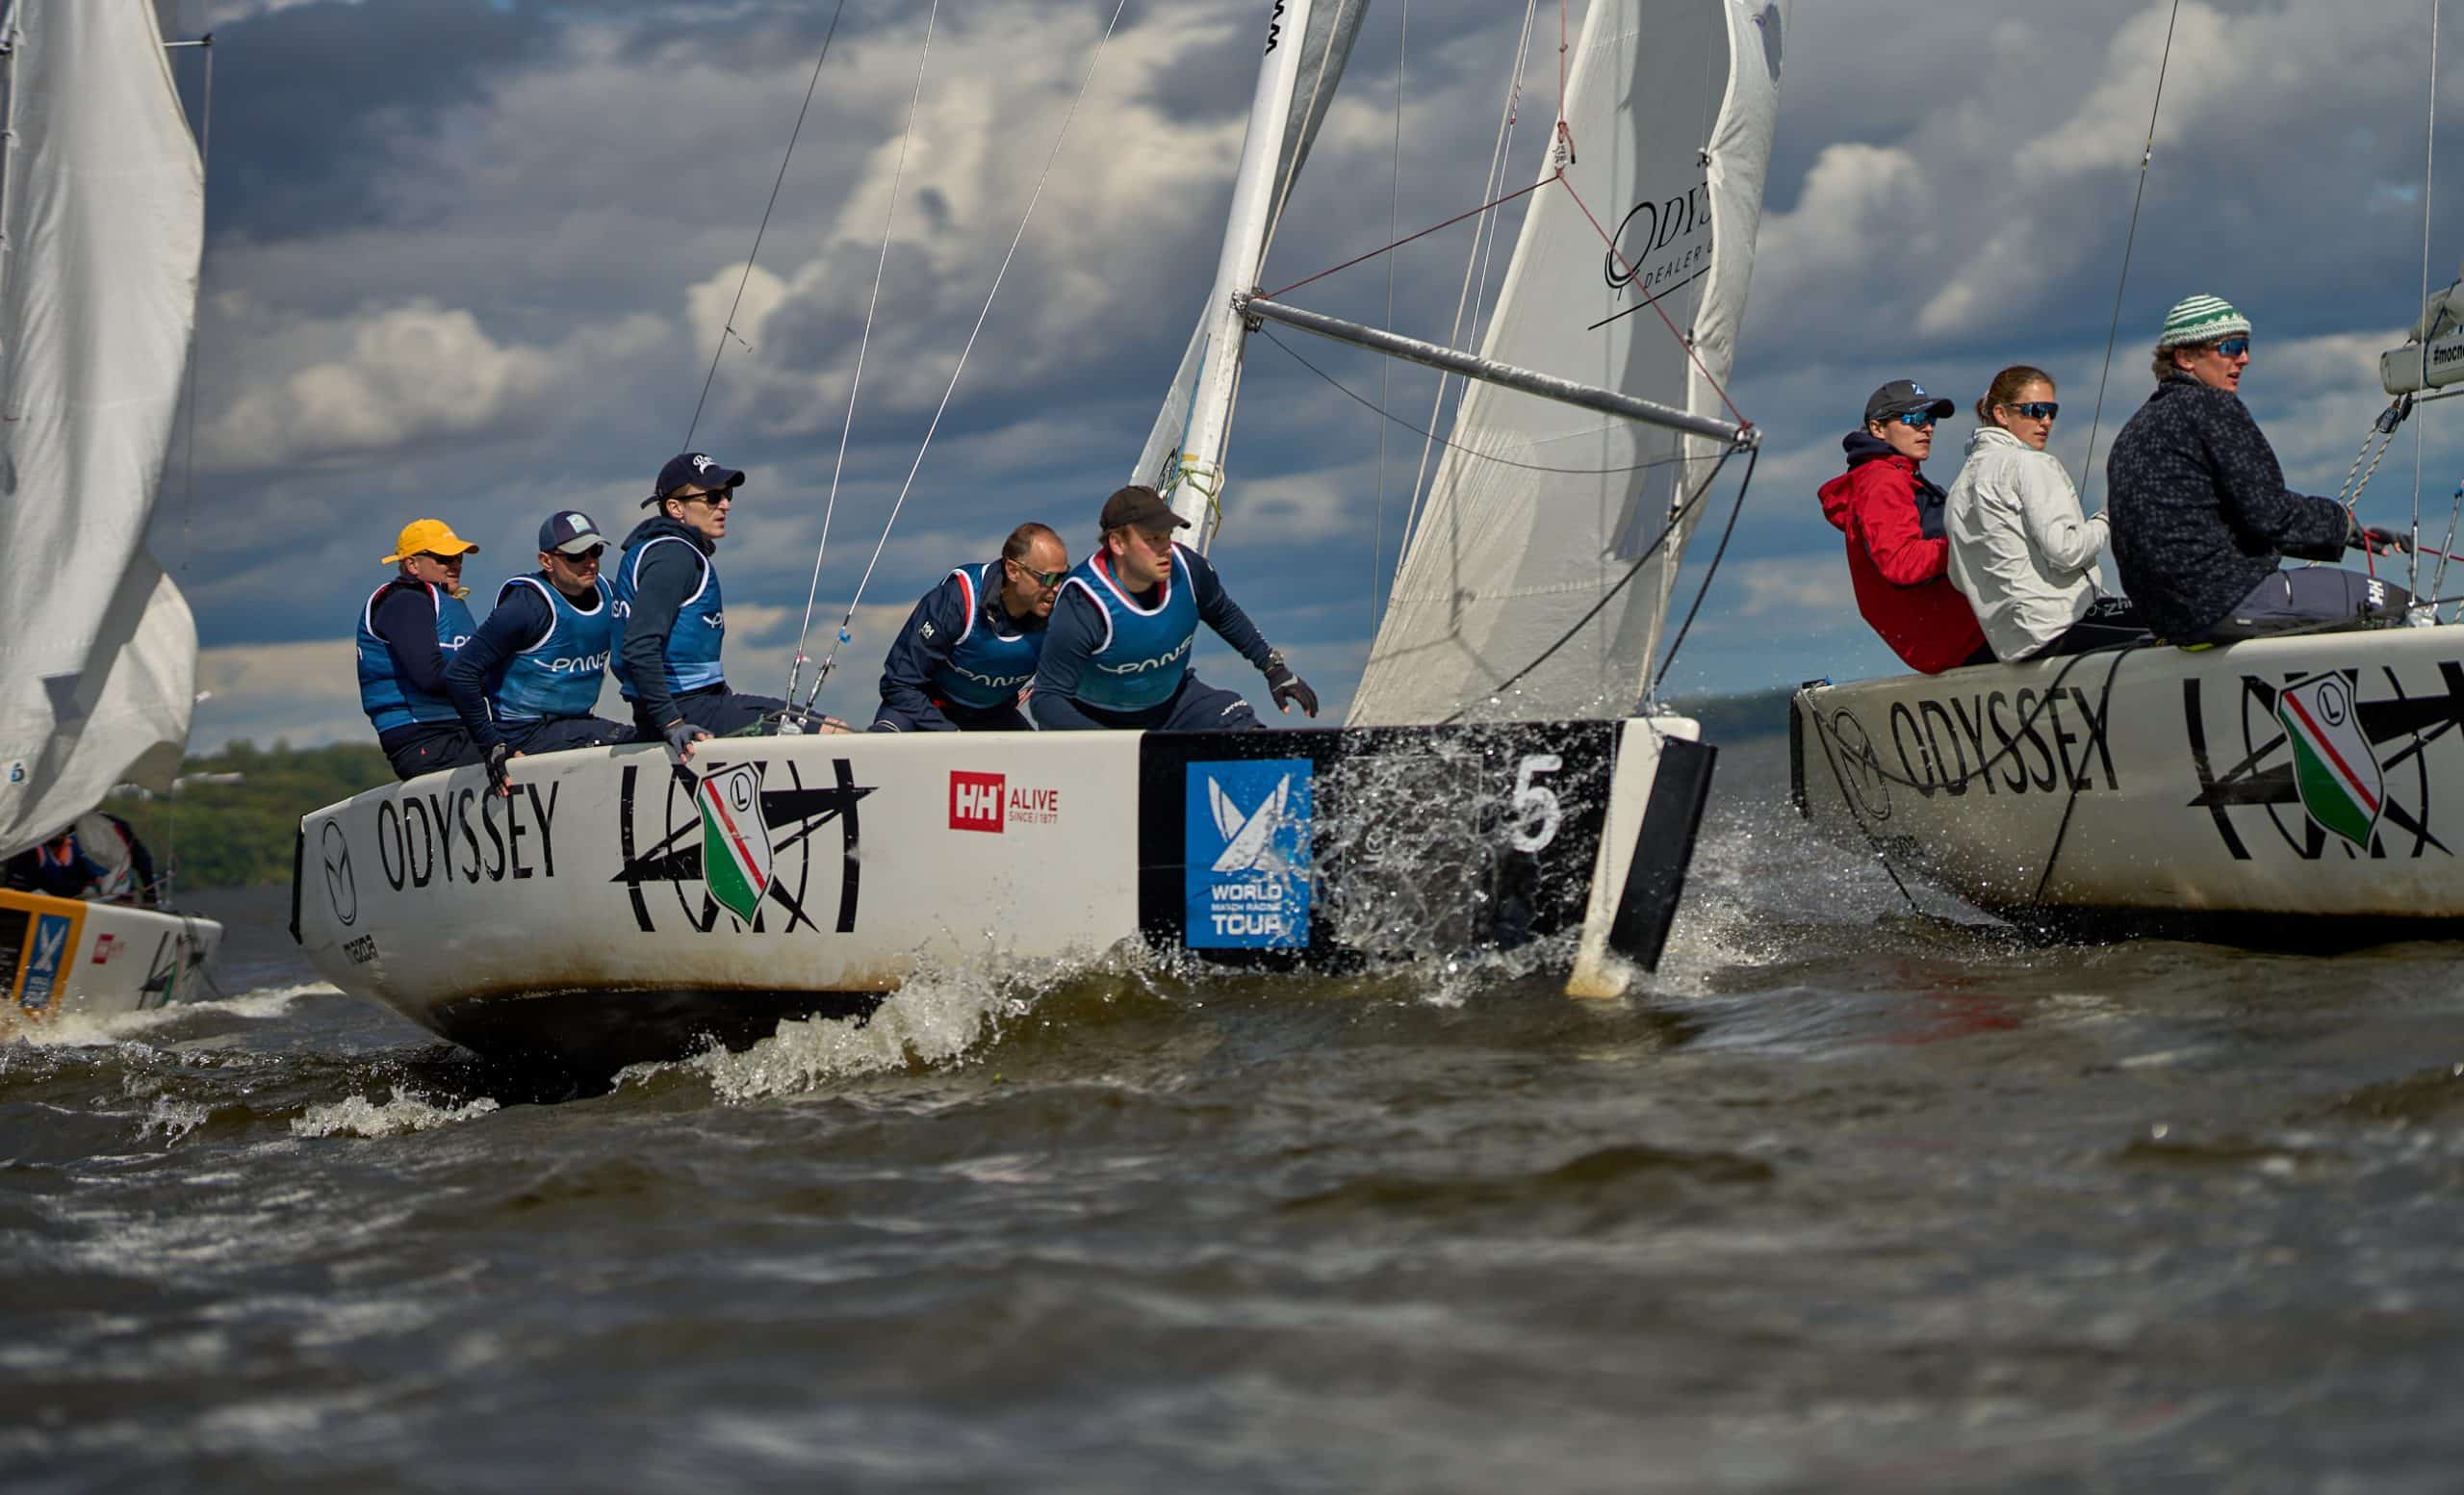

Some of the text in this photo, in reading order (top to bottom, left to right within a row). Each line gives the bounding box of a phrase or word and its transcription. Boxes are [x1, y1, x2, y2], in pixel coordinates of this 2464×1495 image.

[1645, 245, 1702, 289] DEALER
[2433, 344, 2464, 364] #mocn
[1889, 684, 2119, 798] ODYSSEY
[1009, 787, 1059, 812] ALIVE
[1511, 754, 1564, 854] 5
[1008, 811, 1033, 823] SINCE
[377, 780, 560, 892] ODYSSEY
[1211, 885, 1283, 902] WORLD
[1210, 913, 1282, 936] TOUR
